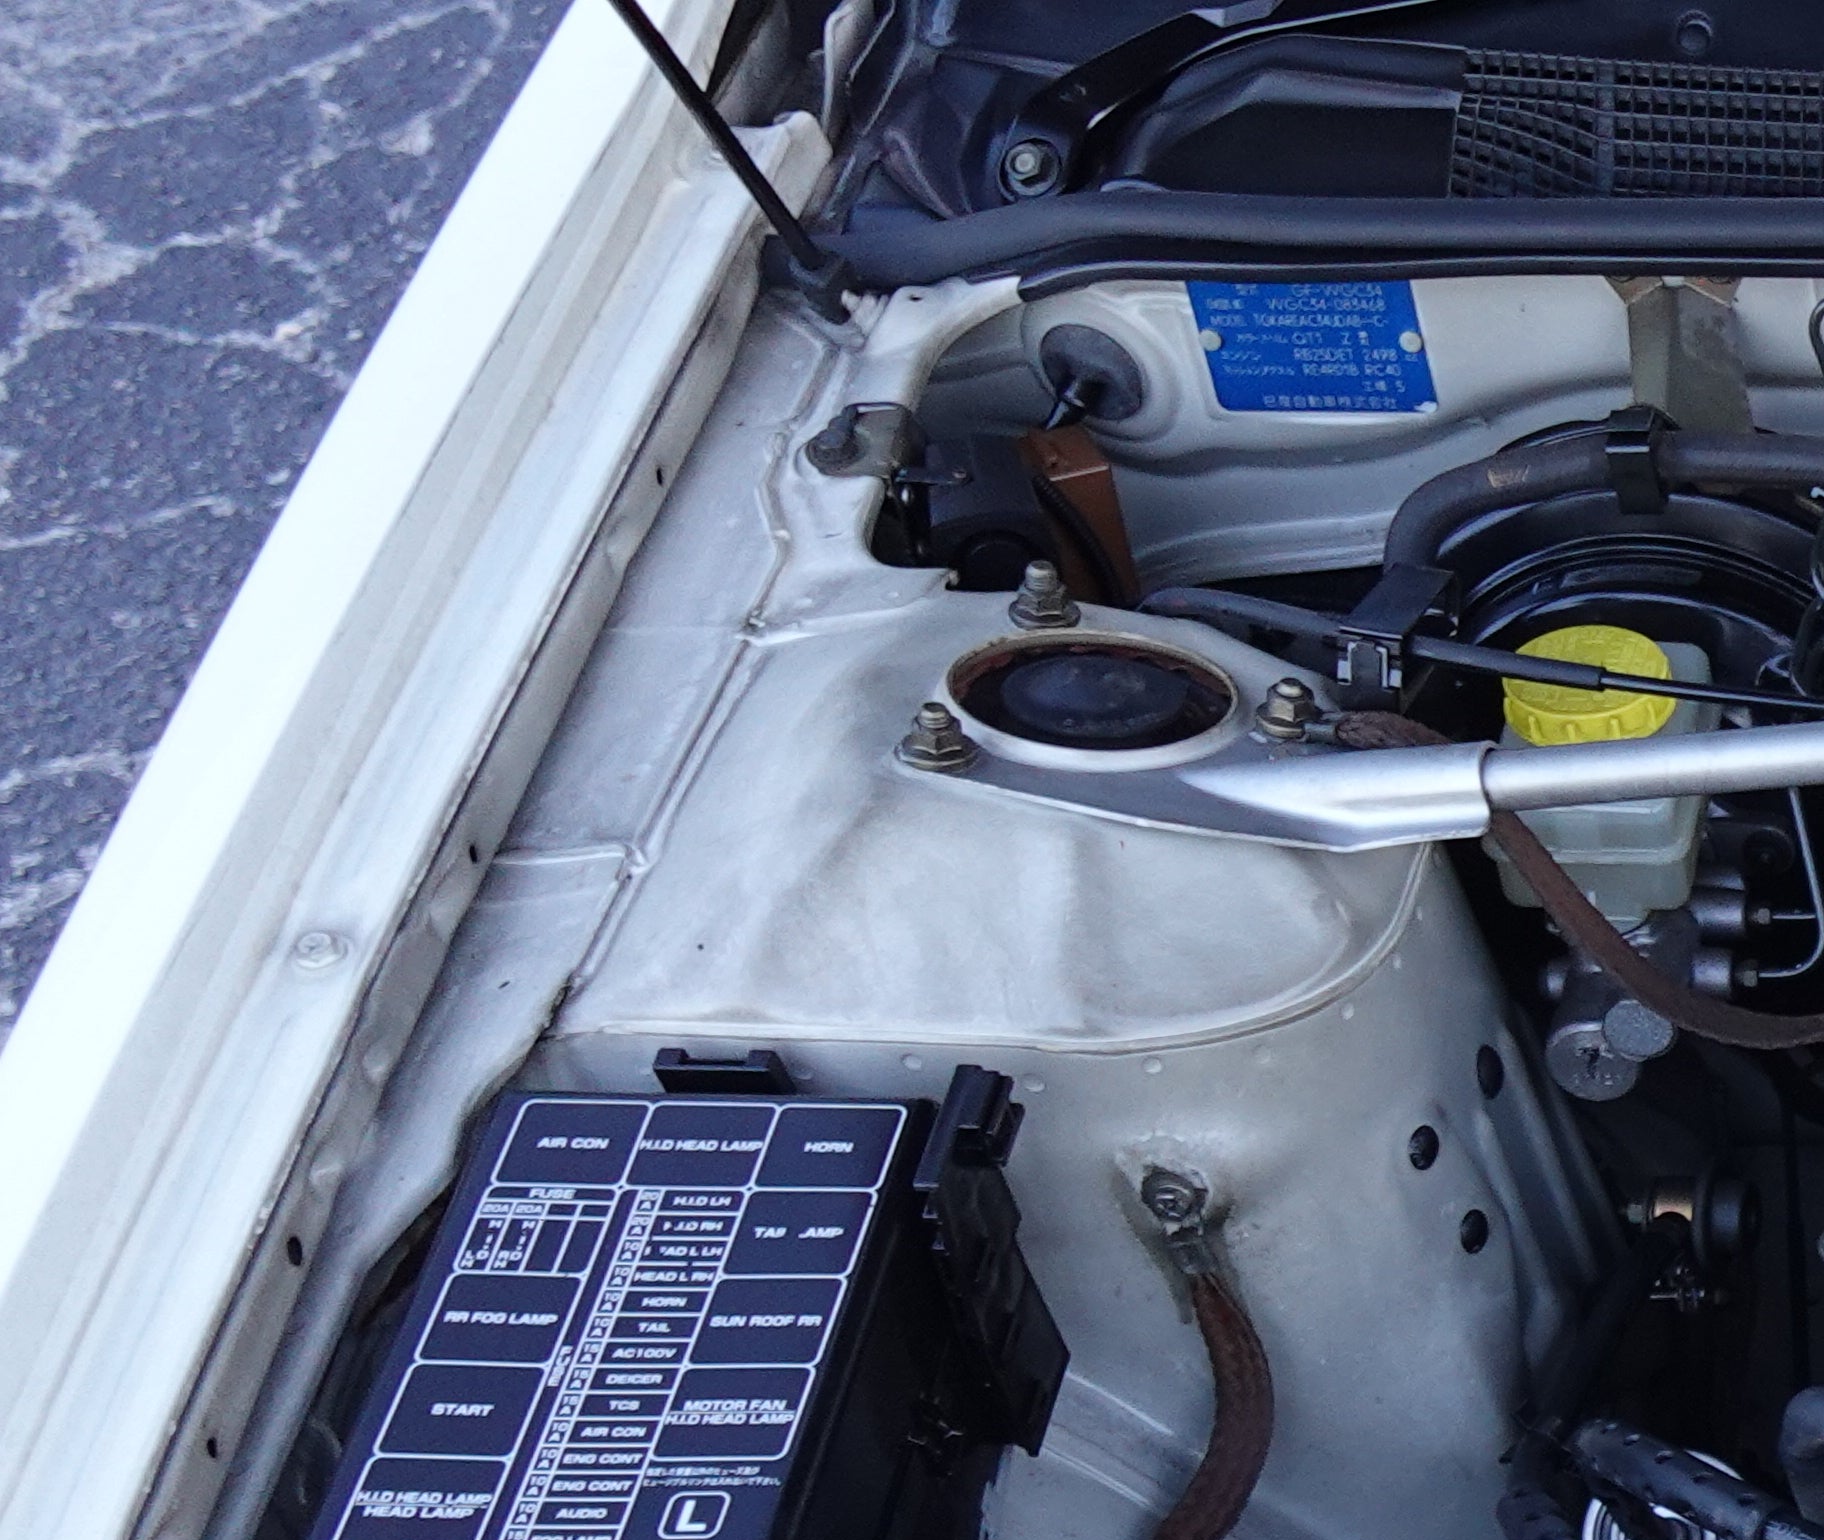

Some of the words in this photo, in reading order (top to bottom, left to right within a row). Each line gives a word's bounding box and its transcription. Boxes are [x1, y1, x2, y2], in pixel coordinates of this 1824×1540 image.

[537, 1137, 566, 1150] AIR
[570, 1137, 609, 1150] CON
[640, 1139, 673, 1151] H.I.D
[676, 1139, 718, 1152] HEAD
[721, 1140, 763, 1152] LAMP
[804, 1141, 854, 1153] HORN
[529, 1188, 576, 1200] FUSE
[709, 1196, 732, 1206] LH
[700, 1221, 724, 1231] RH
[754, 1226, 787, 1239] TAI
[689, 1246, 699, 1256] L
[701, 1246, 724, 1256] LH
[634, 1271, 679, 1282] HEAD
[679, 1271, 688, 1282] L
[691, 1271, 714, 1282] RH
[641, 1296, 687, 1308] HORN
[443, 1312, 469, 1324] RR
[470, 1312, 507, 1324] FOG
[508, 1313, 559, 1325] LAMP
[709, 1316, 747, 1328] SUN
[749, 1315, 795, 1327] ROOF
[796, 1315, 822, 1327] RR
[637, 1322, 671, 1334] TAIL
[612, 1347, 677, 1360] AC100V
[605, 1373, 663, 1385] DEICER
[430, 1403, 495, 1416] START
[608, 1399, 640, 1412] TCS
[682, 1400, 745, 1412] MOTOR
[748, 1400, 786, 1411] FAN
[664, 1414, 698, 1425] H.I.D
[701, 1414, 746, 1425] HEAD
[748, 1414, 795, 1425] LAMP
[580, 1426, 609, 1438] AIR
[610, 1426, 648, 1438] CON
[561, 1453, 597, 1466] ENG
[598, 1452, 644, 1465] CONT
[550, 1480, 587, 1493] ENG
[588, 1479, 633, 1492] CONT
[356, 1491, 394, 1504] H.I.D
[395, 1491, 444, 1504] HEAD
[445, 1490, 493, 1504] LAMP
[362, 1507, 419, 1519] HEAD
[421, 1506, 476, 1519] LAMP
[555, 1508, 609, 1520] AUDIO
[675, 1499, 707, 1532] L
